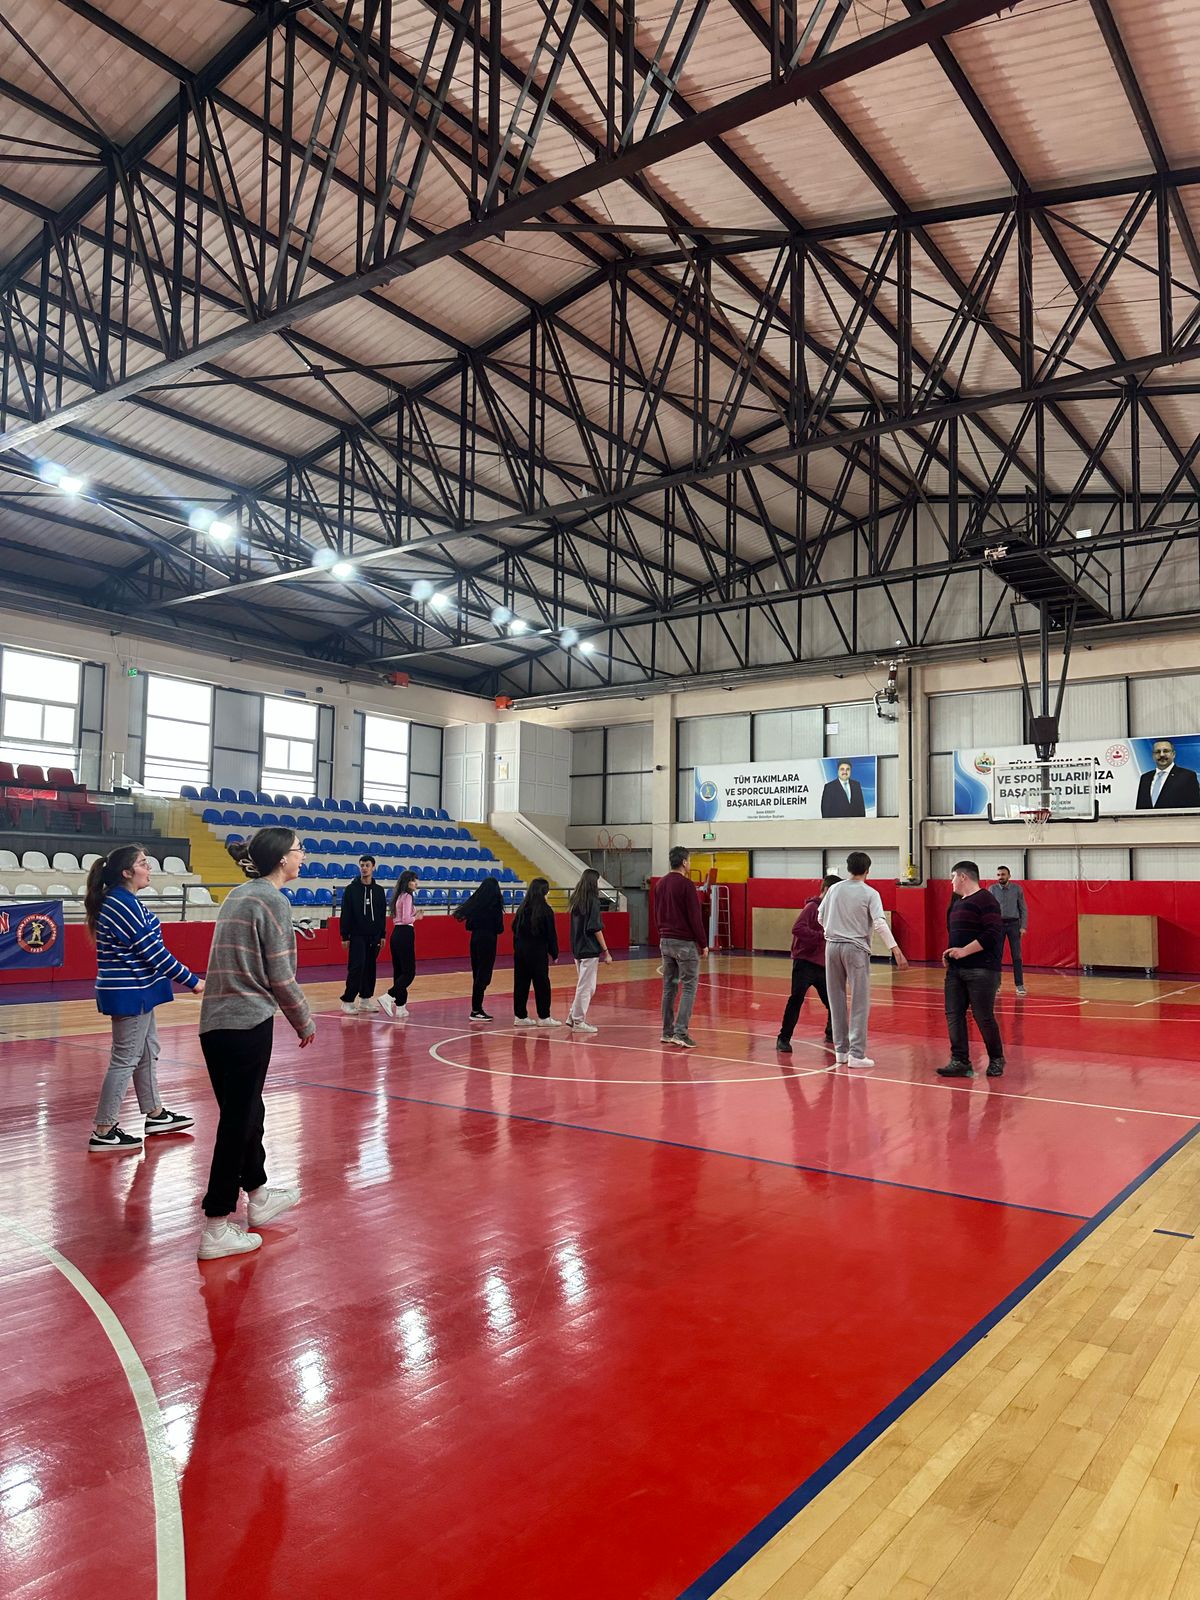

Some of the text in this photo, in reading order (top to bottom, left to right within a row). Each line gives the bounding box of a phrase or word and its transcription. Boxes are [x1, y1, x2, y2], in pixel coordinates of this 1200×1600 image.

[1009, 757, 1101, 770] TÜM TKIMLARA
[734, 773, 800, 784] TÜM TAKIMLARA
[997, 770, 1114, 784] VE SPORULARIMIZA
[725, 785, 809, 796] VE SPORCULARIMIZA
[726, 795, 807, 808] BAŞARILAR DİLERİM
